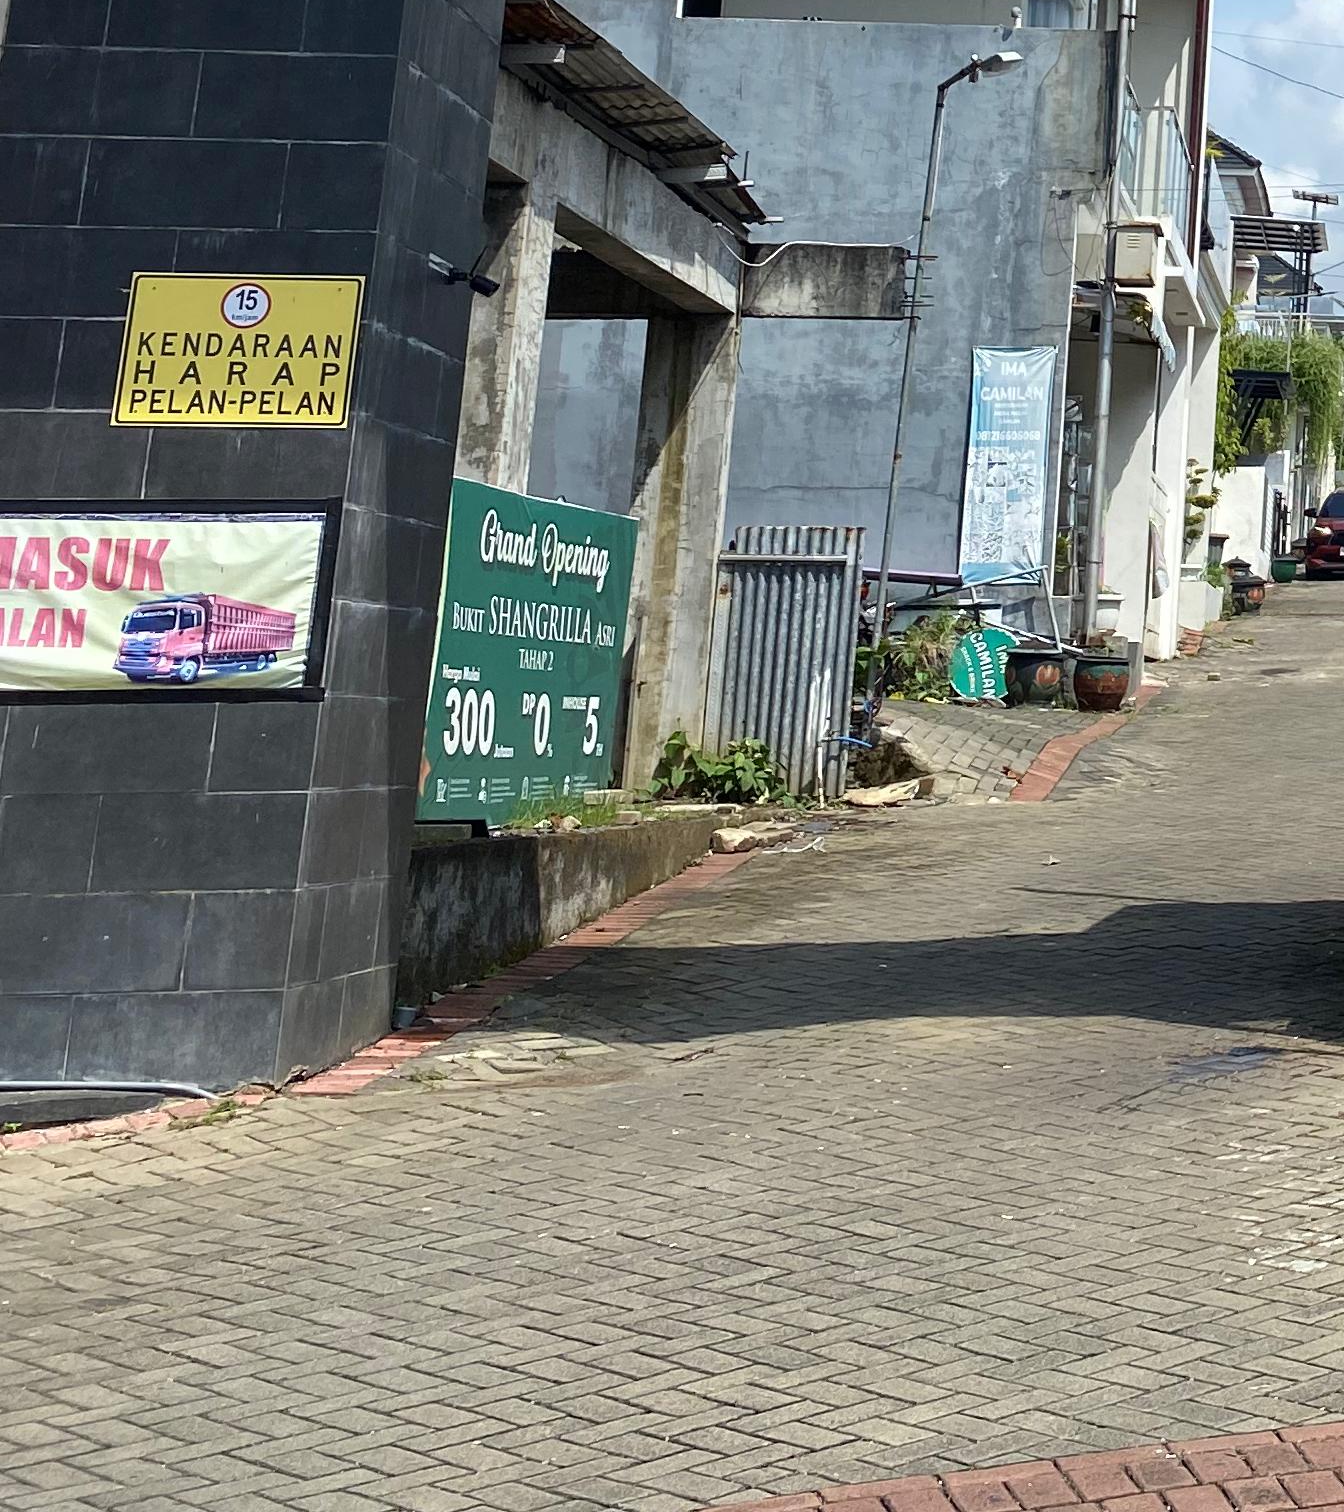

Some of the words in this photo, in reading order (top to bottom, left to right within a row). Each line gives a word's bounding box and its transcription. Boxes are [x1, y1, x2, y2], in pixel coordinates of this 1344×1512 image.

[236, 289, 259, 311] 15
[137, 332, 342, 359] KENDARAAN
[133, 360, 341, 387] HARAP
[1001, 361, 1027, 377] IMA
[129, 389, 336, 416] PELAN-PELAN
[980, 386, 1044, 401] CAMILAN
[480, 509, 538, 568] Grand
[541, 523, 611, 593] Opening
[0, 607, 87, 649] LAN
[488, 595, 592, 644] SHANGRILLA
[518, 648, 547, 671] TAHAP
[546, 651, 554, 671] 2
[969, 632, 996, 699] CAMILAN
[521, 692, 536, 716] DP
[443, 686, 496, 756] 300
[582, 696, 601, 755] 5
